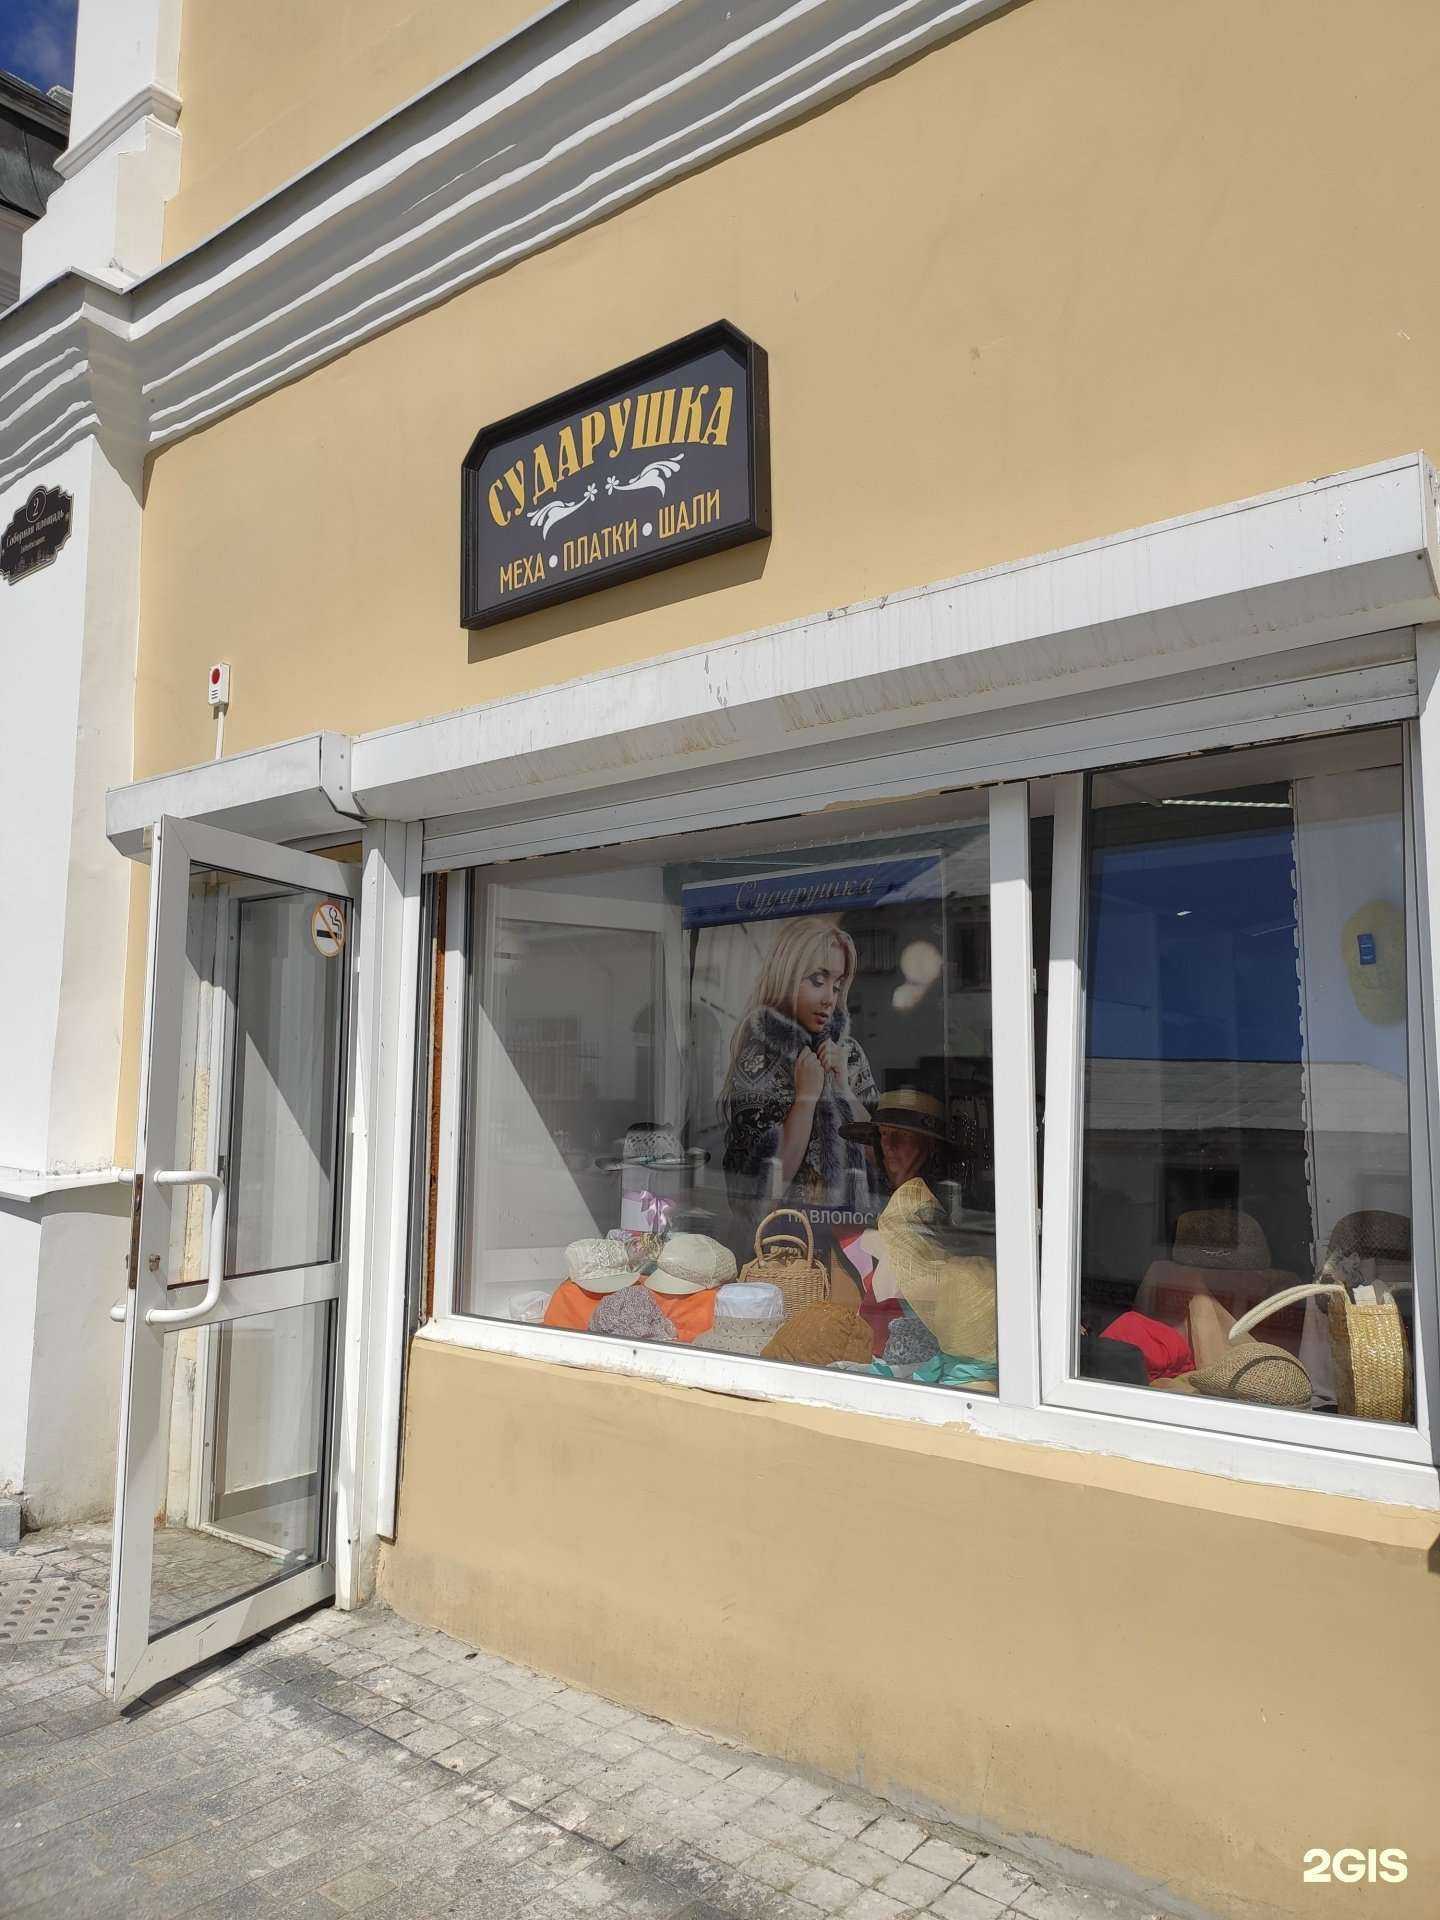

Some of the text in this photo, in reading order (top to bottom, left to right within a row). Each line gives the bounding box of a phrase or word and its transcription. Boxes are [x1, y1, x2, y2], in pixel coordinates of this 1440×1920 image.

[32, 497, 39, 517] 2
[488, 385, 733, 527] СУДАРУШКА
[500, 489, 721, 594] МЕХА ПЛАТКИ ШАЛИ
